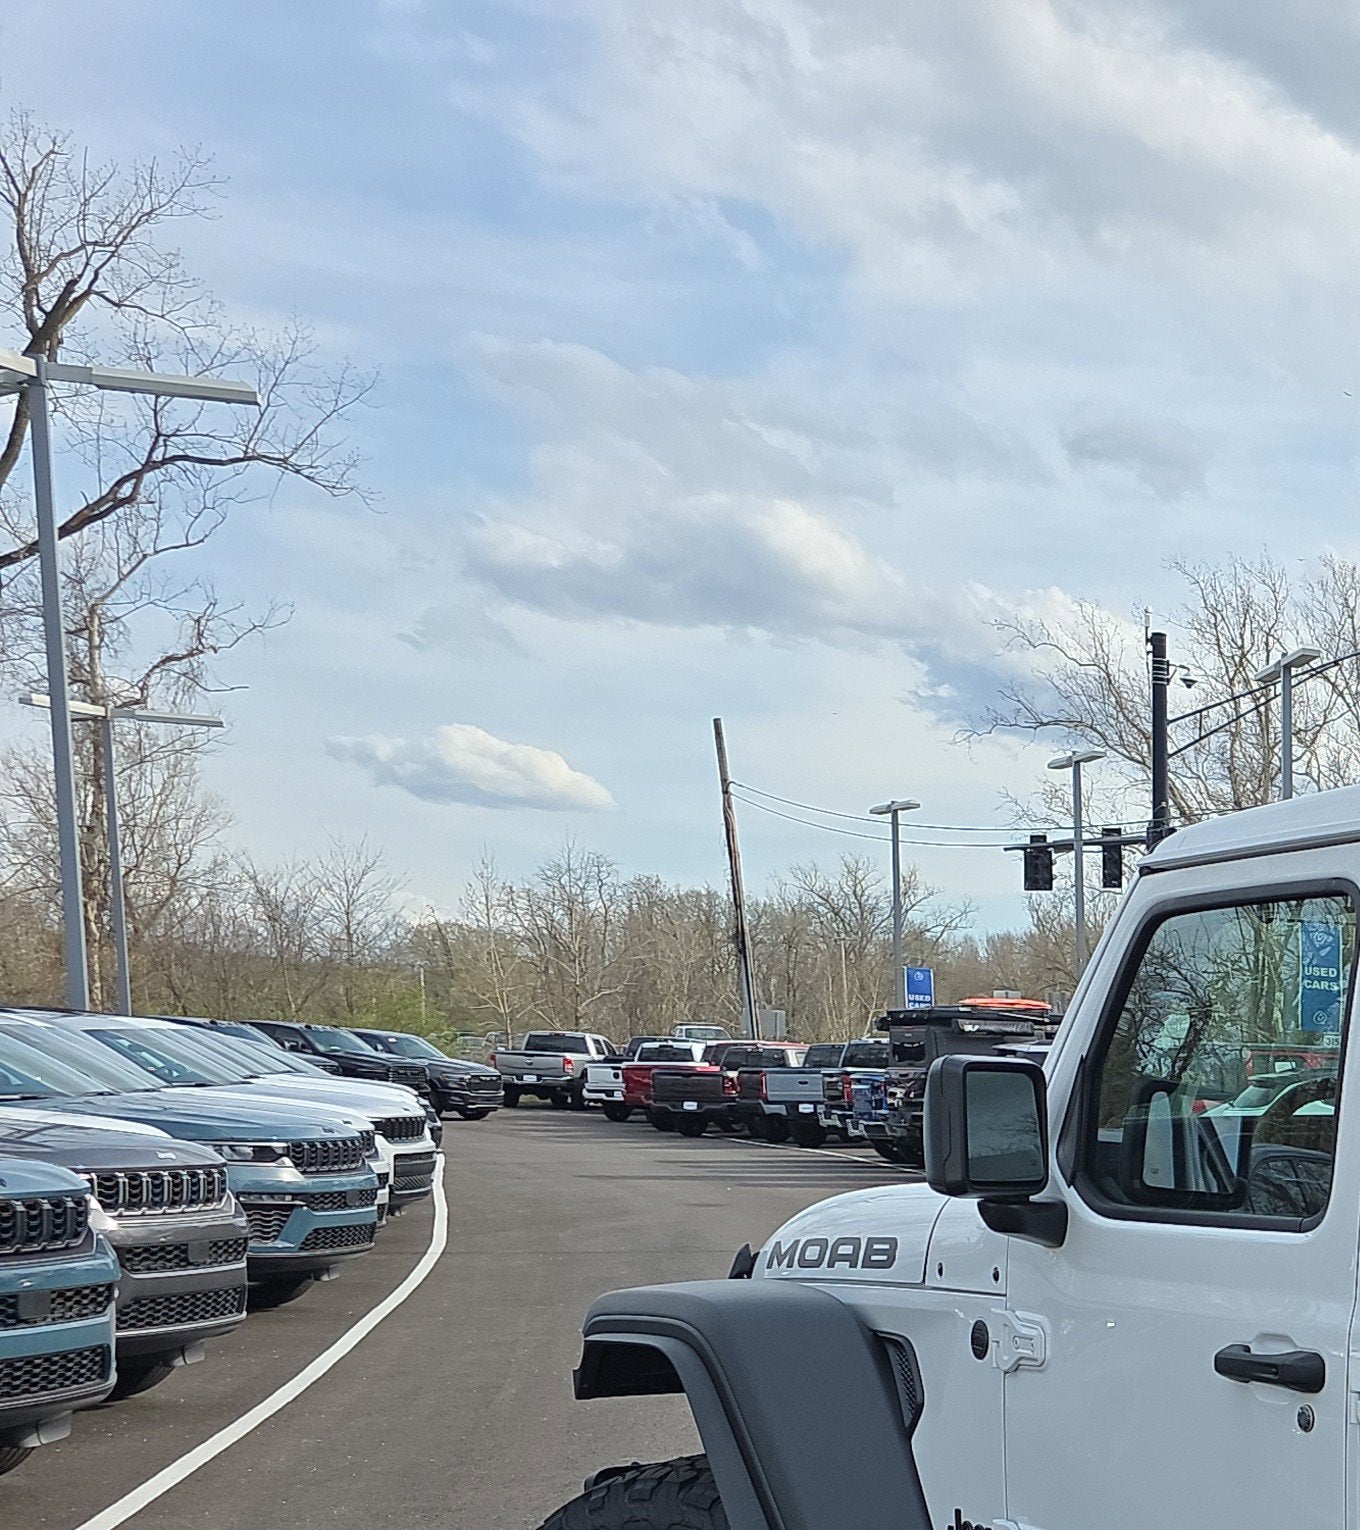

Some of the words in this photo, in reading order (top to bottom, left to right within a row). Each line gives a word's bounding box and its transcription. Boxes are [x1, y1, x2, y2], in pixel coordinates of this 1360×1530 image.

[1304, 966, 1337, 977] USED
[1304, 979, 1339, 991] CARS
[909, 993, 931, 1002] USED
[766, 1236, 898, 1269] MOAB
